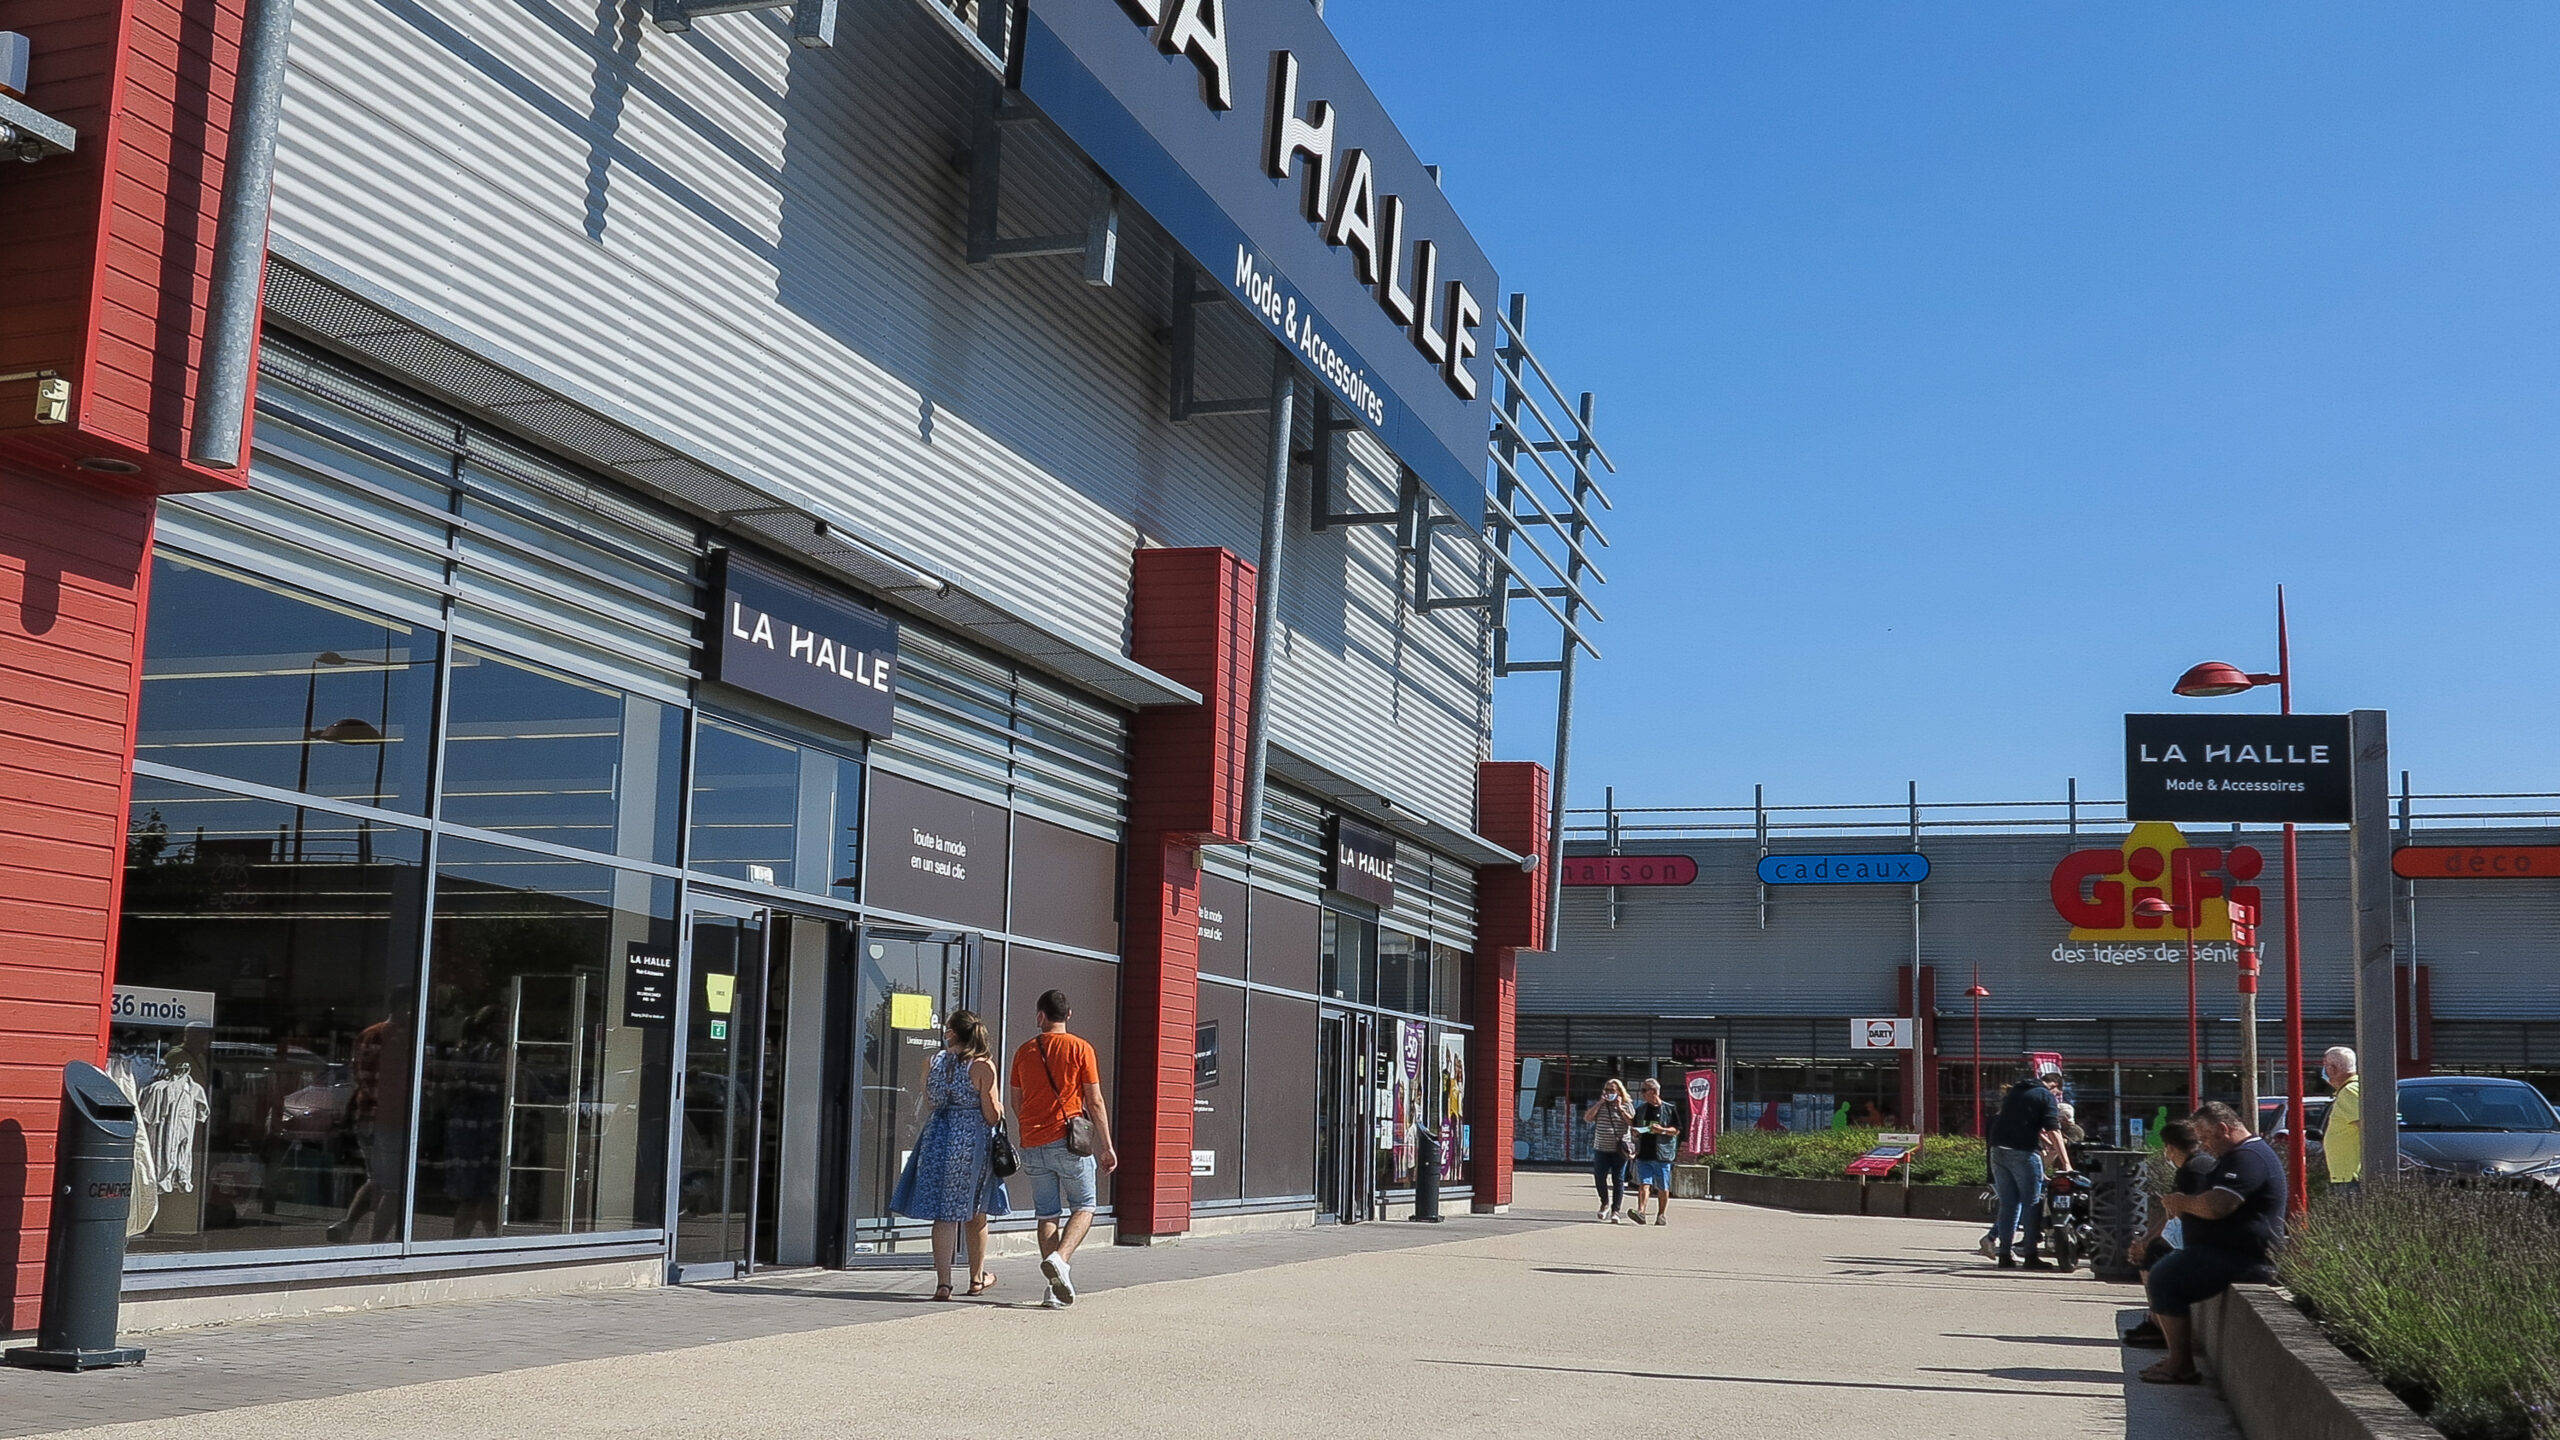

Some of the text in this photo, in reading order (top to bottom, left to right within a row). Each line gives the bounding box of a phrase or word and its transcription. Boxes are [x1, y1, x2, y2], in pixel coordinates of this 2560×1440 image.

[1268, 50, 1482, 400] HALLE
[1235, 243, 1384, 427] Mode & Accessoires
[732, 602, 890, 693] LA HALLE
[2141, 744, 2330, 764] LA HALLE
[2166, 779, 2305, 792] Mode & Accessoires
[912, 828, 966, 857] Toute la mode
[911, 856, 966, 880] en un seul clic
[1340, 844, 1393, 883] LA HALLE
[1775, 858, 1911, 879] cadeaux
[2445, 848, 2531, 872] déco
[630, 954, 671, 968] LA HALLE
[2052, 943, 2086, 963] des
[2094, 943, 2147, 965] idées
[2154, 942, 2181, 963] de
[140, 997, 186, 1019] mois
[1868, 1030, 1893, 1038] DARTY
